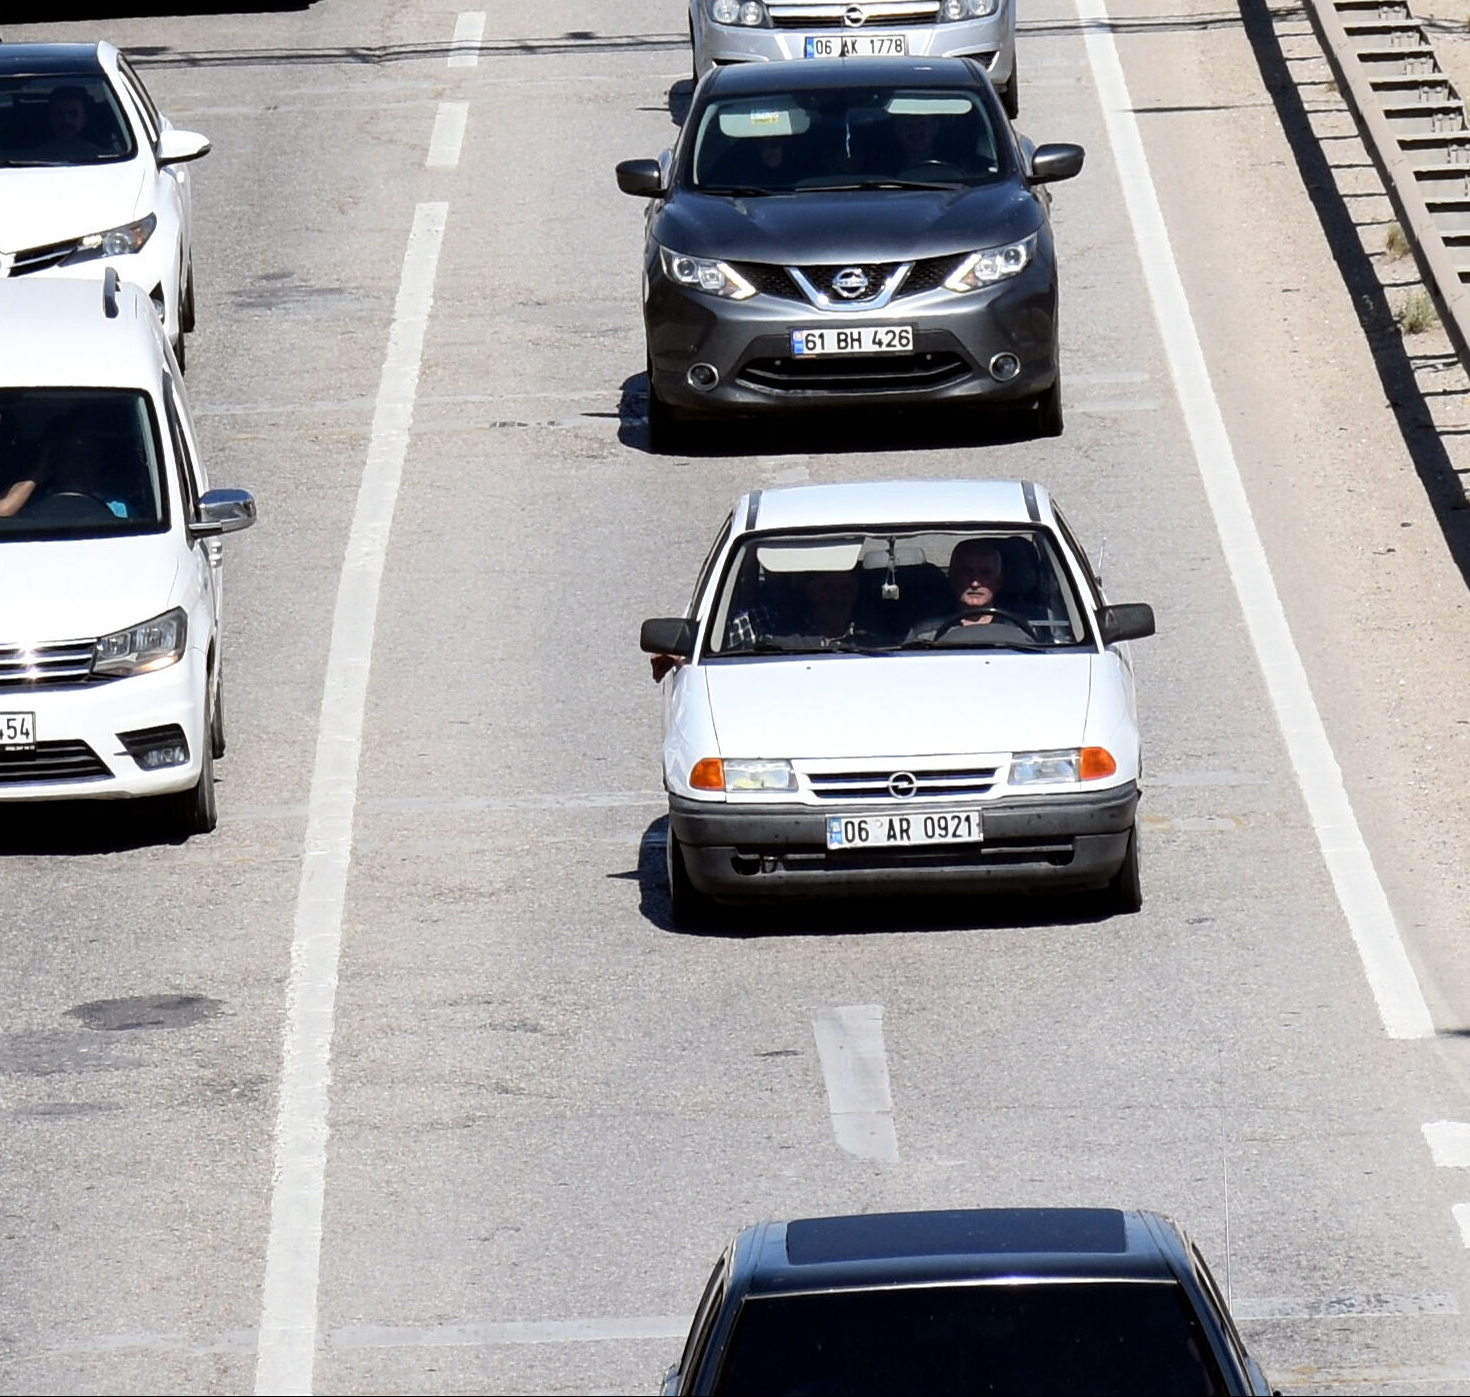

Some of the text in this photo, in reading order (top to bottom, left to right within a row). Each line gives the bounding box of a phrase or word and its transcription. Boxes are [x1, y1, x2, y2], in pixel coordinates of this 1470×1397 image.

[815, 39, 833, 55] 06
[869, 38, 904, 54] 1778
[804, 329, 911, 351] 61 BH 426
[844, 814, 972, 843] 06 AR 0921
